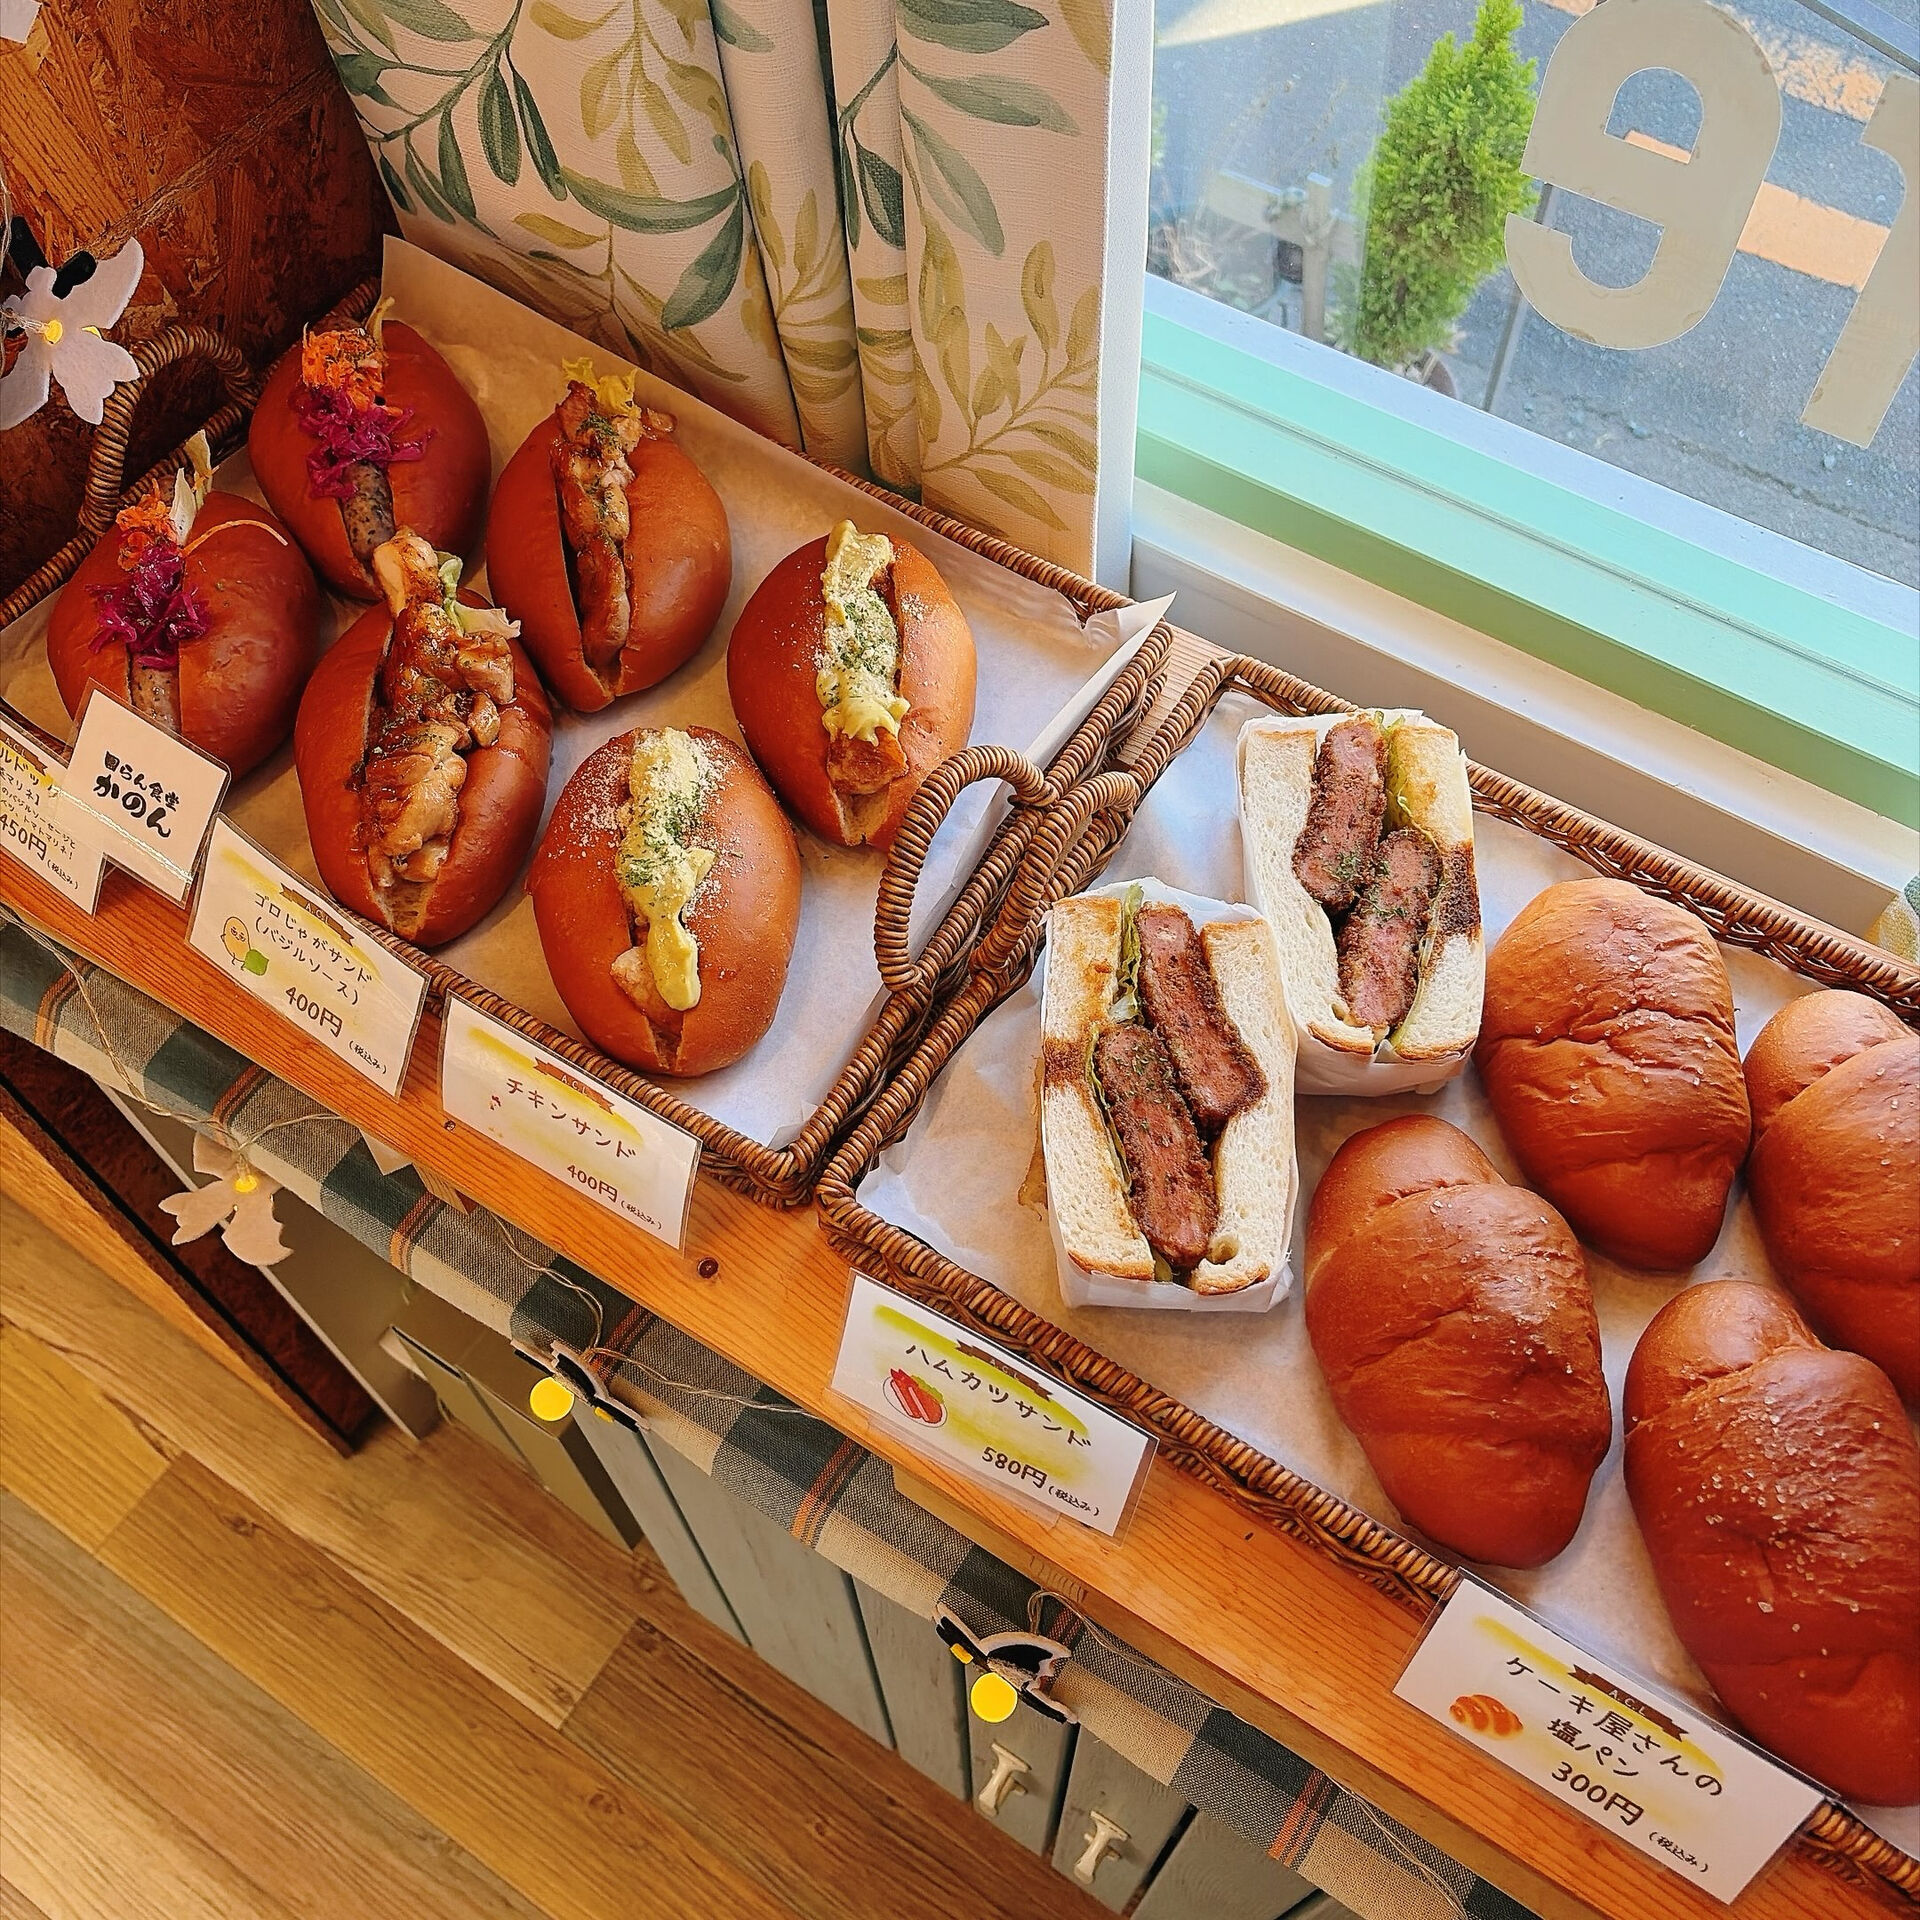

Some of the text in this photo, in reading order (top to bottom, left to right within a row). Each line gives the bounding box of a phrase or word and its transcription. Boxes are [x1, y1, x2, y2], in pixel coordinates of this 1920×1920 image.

[0, 813, 47, 861] 450円
[93, 774, 171, 838] かのん
[254, 893, 373, 984] ゴロじゃがサンド
[255, 916, 359, 1006] (バジルソース)
[285, 986, 343, 1038] 400円
[506, 1078, 636, 1158] チキンサンド
[567, 1164, 618, 1203] 400円
[905, 1345, 1091, 1447] ハムカツサンド
[982, 1446, 1048, 1489] 580円
[1506, 1657, 1723, 1796] ケーキ屋さんの
[1547, 1718, 1639, 1777] 塩パン
[1551, 1761, 1644, 1826] 300円
